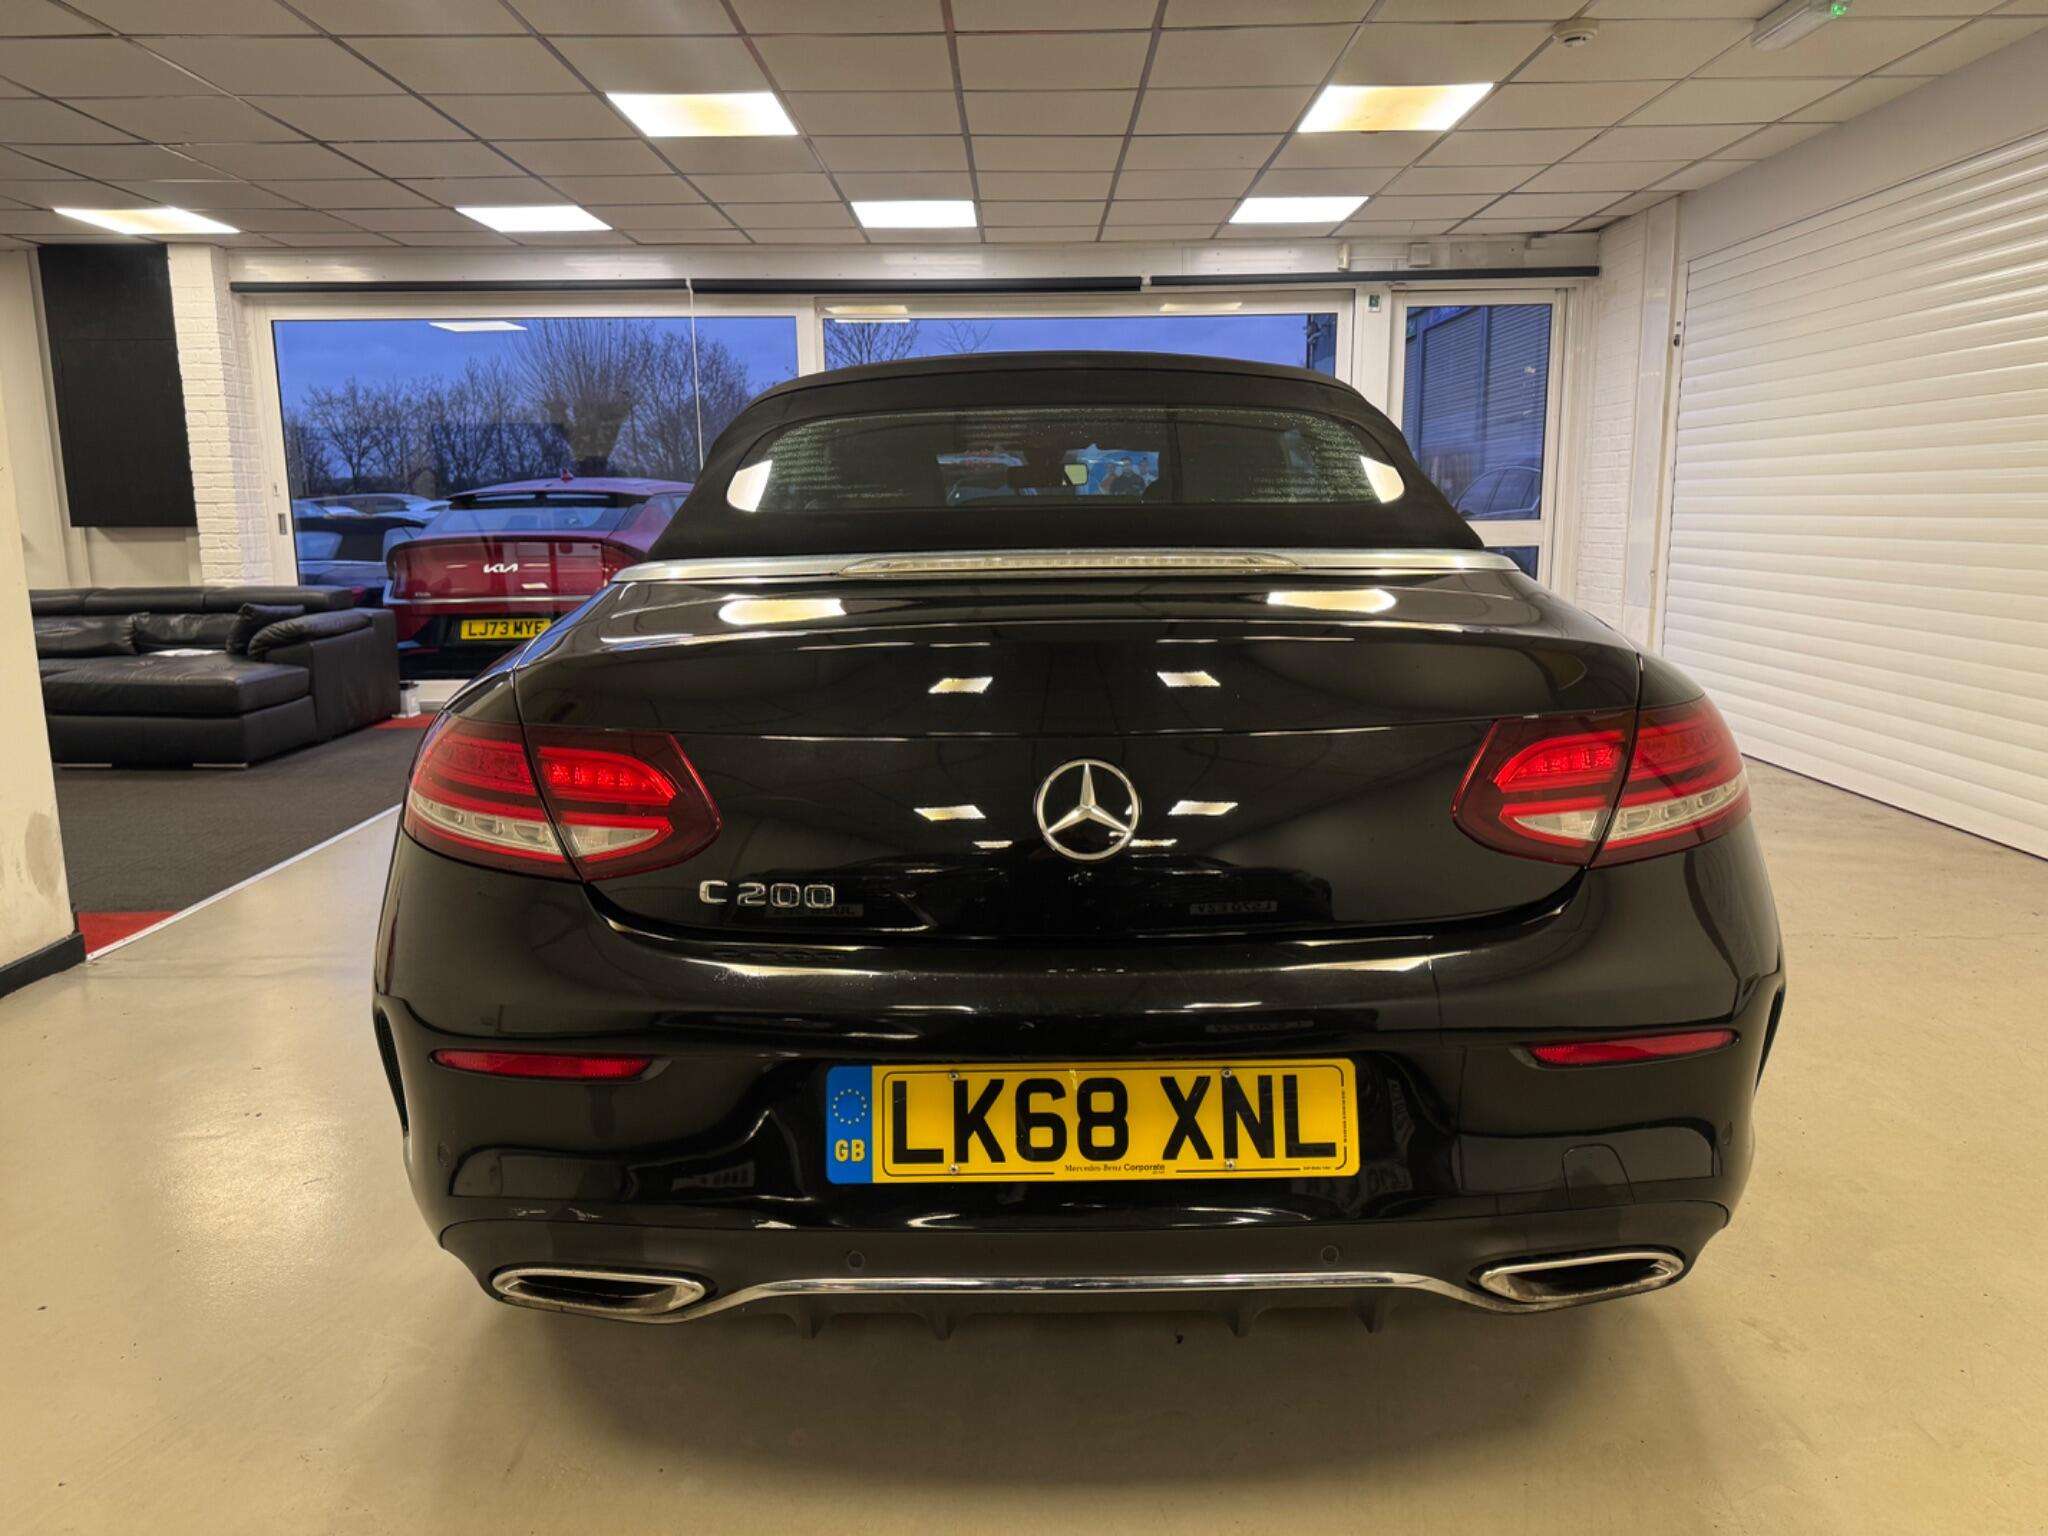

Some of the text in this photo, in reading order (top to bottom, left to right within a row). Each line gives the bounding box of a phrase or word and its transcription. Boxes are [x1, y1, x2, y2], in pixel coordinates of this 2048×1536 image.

[483, 564, 518, 573] KIA
[468, 622, 509, 636] LJ73
[699, 880, 835, 909] C 200
[892, 1077, 1130, 1164] LK68
[1160, 1075, 1337, 1161] XNL
[835, 1139, 866, 1162] GB
[1124, 1163, 1165, 1172] Corporate
